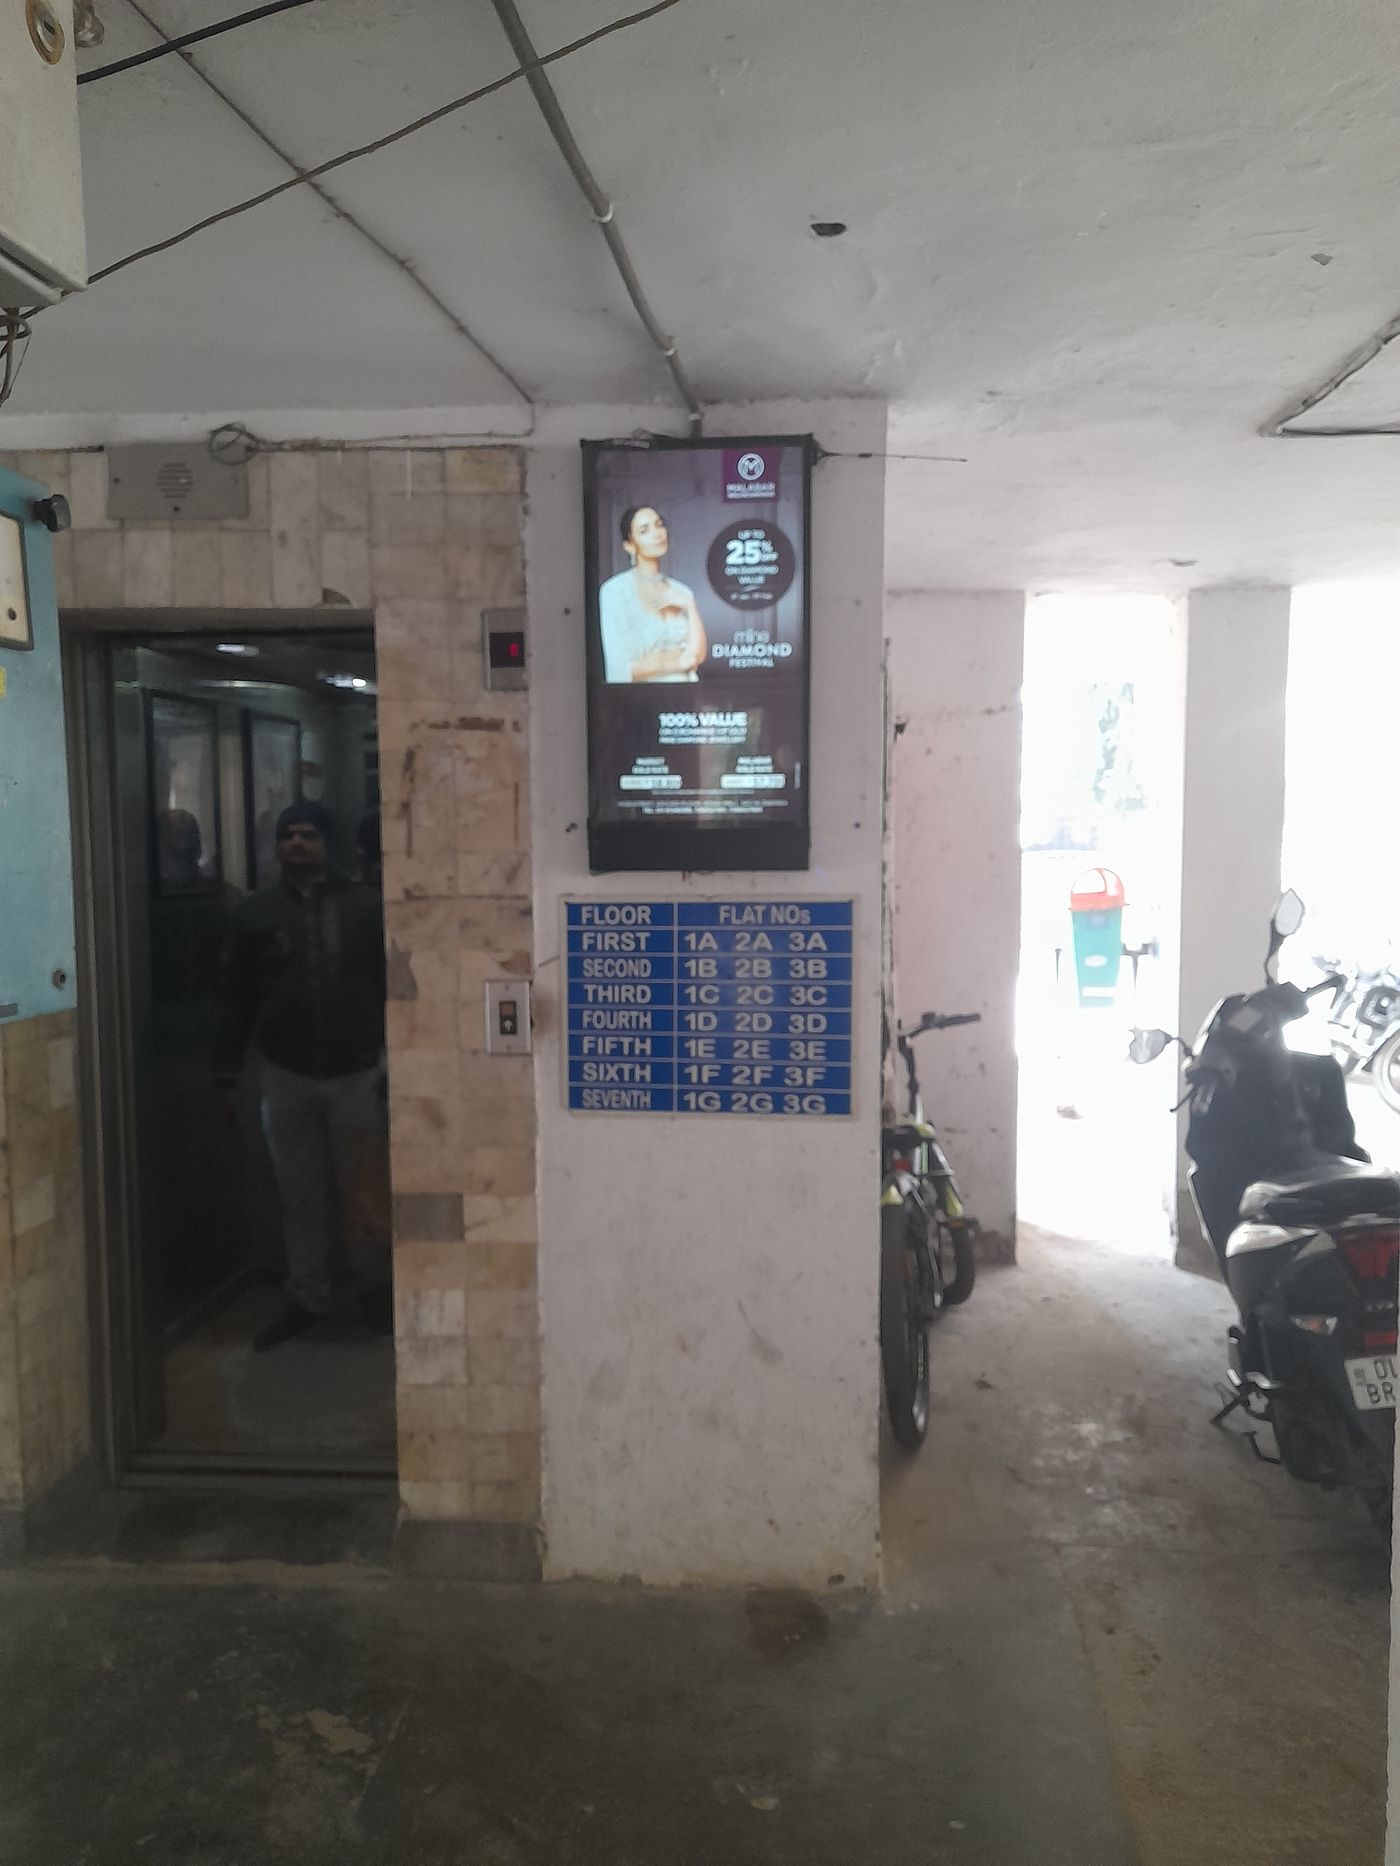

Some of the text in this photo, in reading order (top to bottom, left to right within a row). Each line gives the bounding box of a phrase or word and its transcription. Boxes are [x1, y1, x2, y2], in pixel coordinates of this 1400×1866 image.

[711, 642, 793, 658] DIAMOND
[728, 657, 776, 669] FESTIVAL
[658, 711, 748, 727] 100% VALUE
[581, 905, 651, 925] FLOOR
[719, 905, 767, 925] FLAT
[582, 932, 828, 951] FIRST 1A 2A 3A
[582, 958, 828, 979] SECOND 1B 2B 3B
[583, 984, 828, 1006] THIRD 1C 2C 3C
[582, 1010, 828, 1033] FOURTH 1D 2D 3D
[582, 1036, 828, 1061] FIFTH 1E 2E 3E
[582, 1062, 827, 1087] SIXTH 1F 2F 3F
[582, 1088, 827, 1115] SEVENTH 1G 2G 3G
